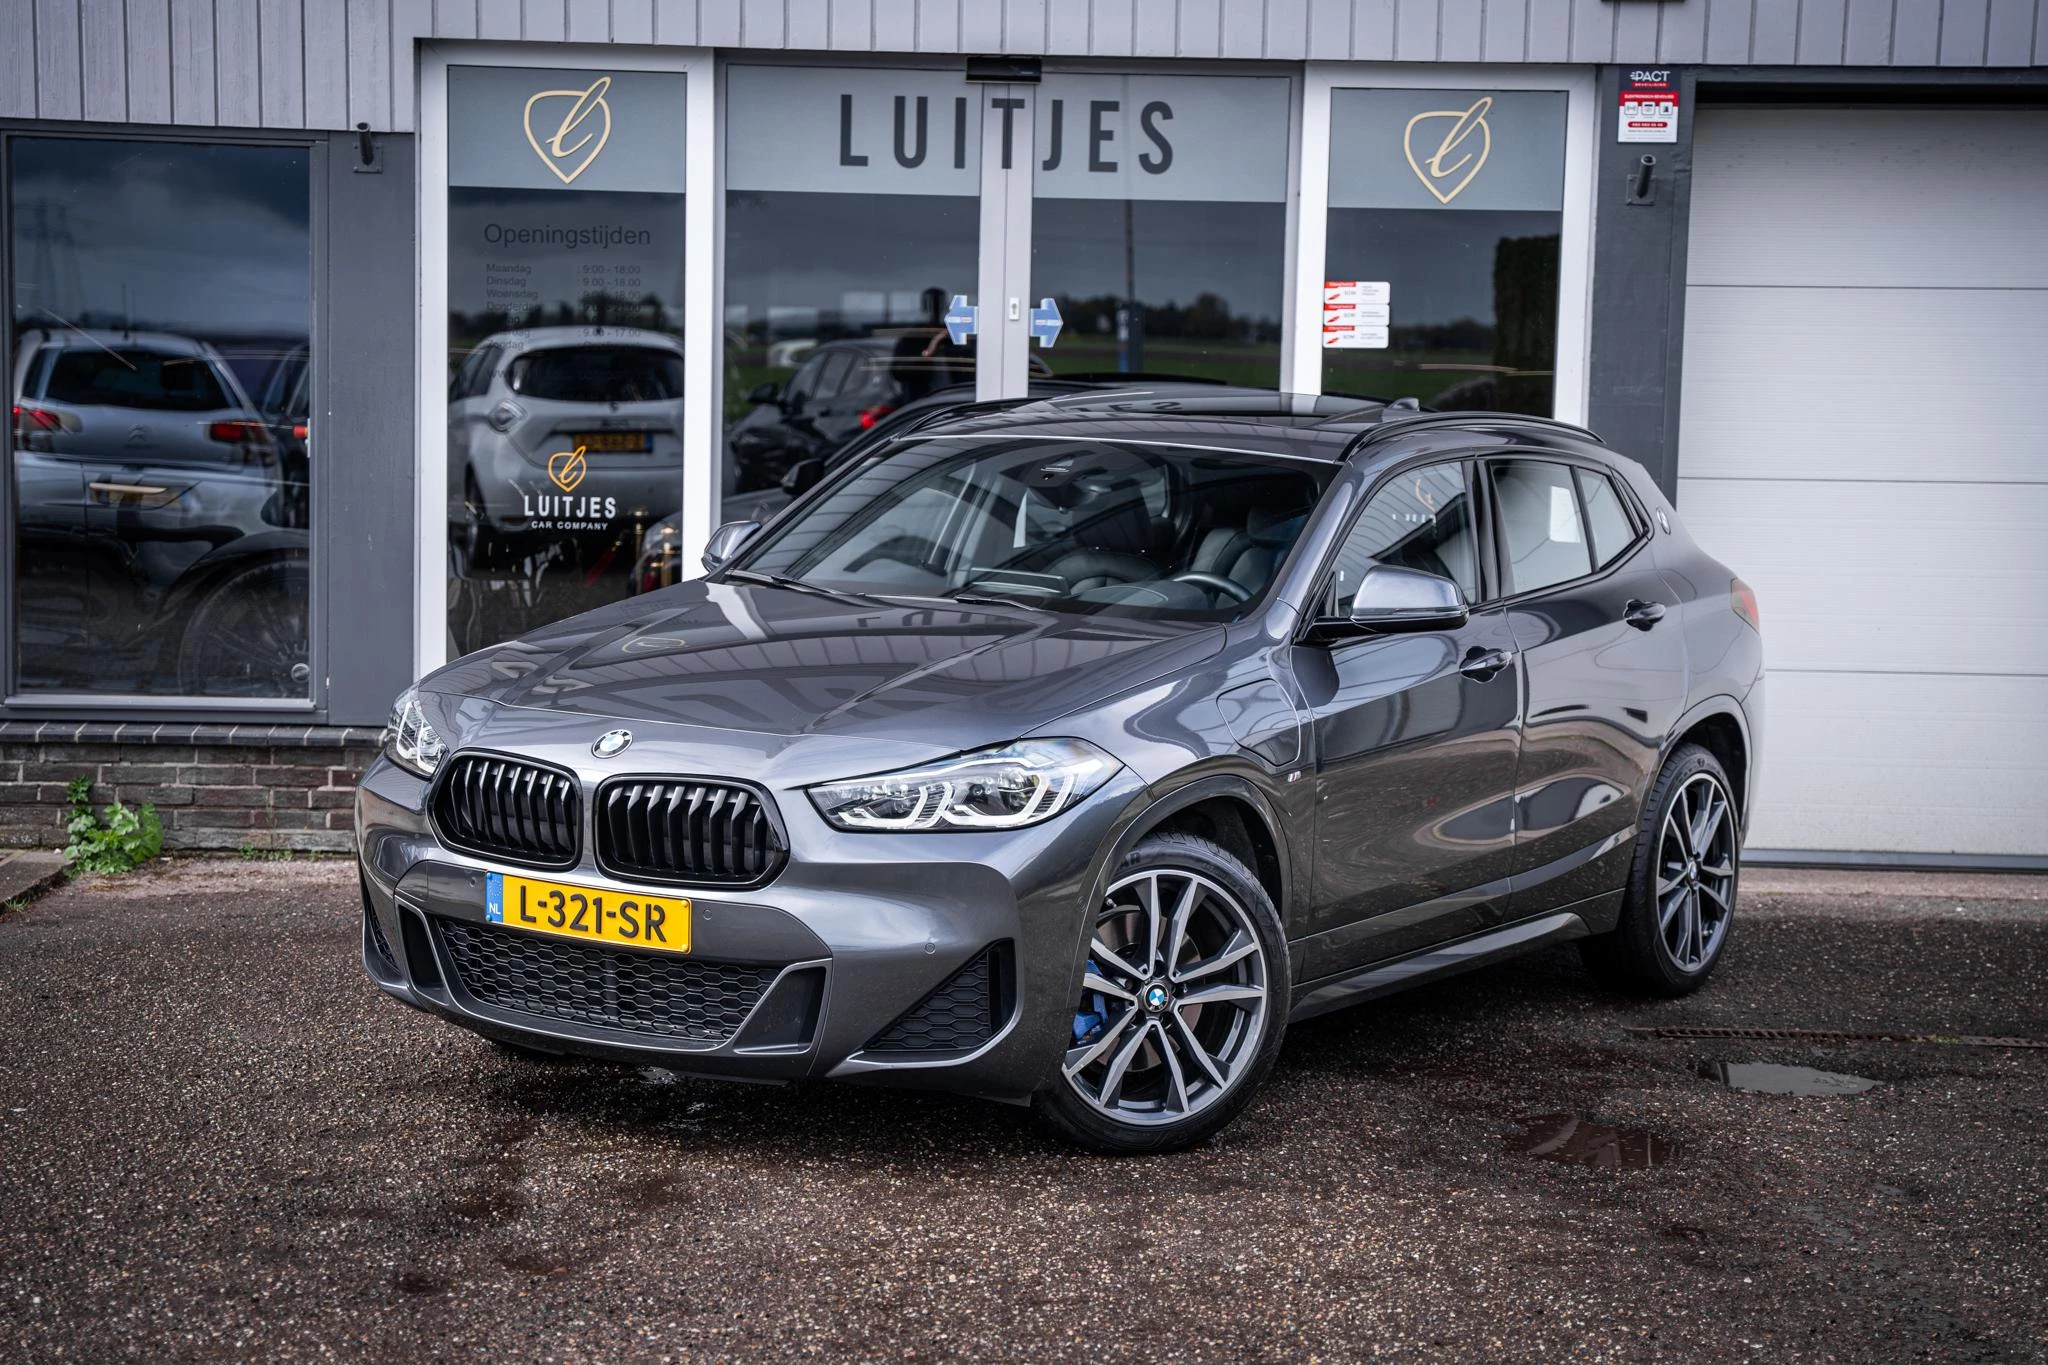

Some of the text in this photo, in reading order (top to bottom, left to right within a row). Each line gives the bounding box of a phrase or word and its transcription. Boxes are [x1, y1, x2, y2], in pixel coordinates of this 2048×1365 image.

[1630, 70, 1671, 82] PACT
[839, 94, 1174, 175] LUITJES
[484, 223, 651, 249] Openingstijden
[486, 263, 532, 276] Maandag
[486, 276, 527, 288] Dinsdag
[524, 495, 617, 518] LUITJES
[531, 521, 608, 530] CAR COMPANY
[489, 903, 501, 915] NL
[520, 885, 667, 943] L-321-SR
